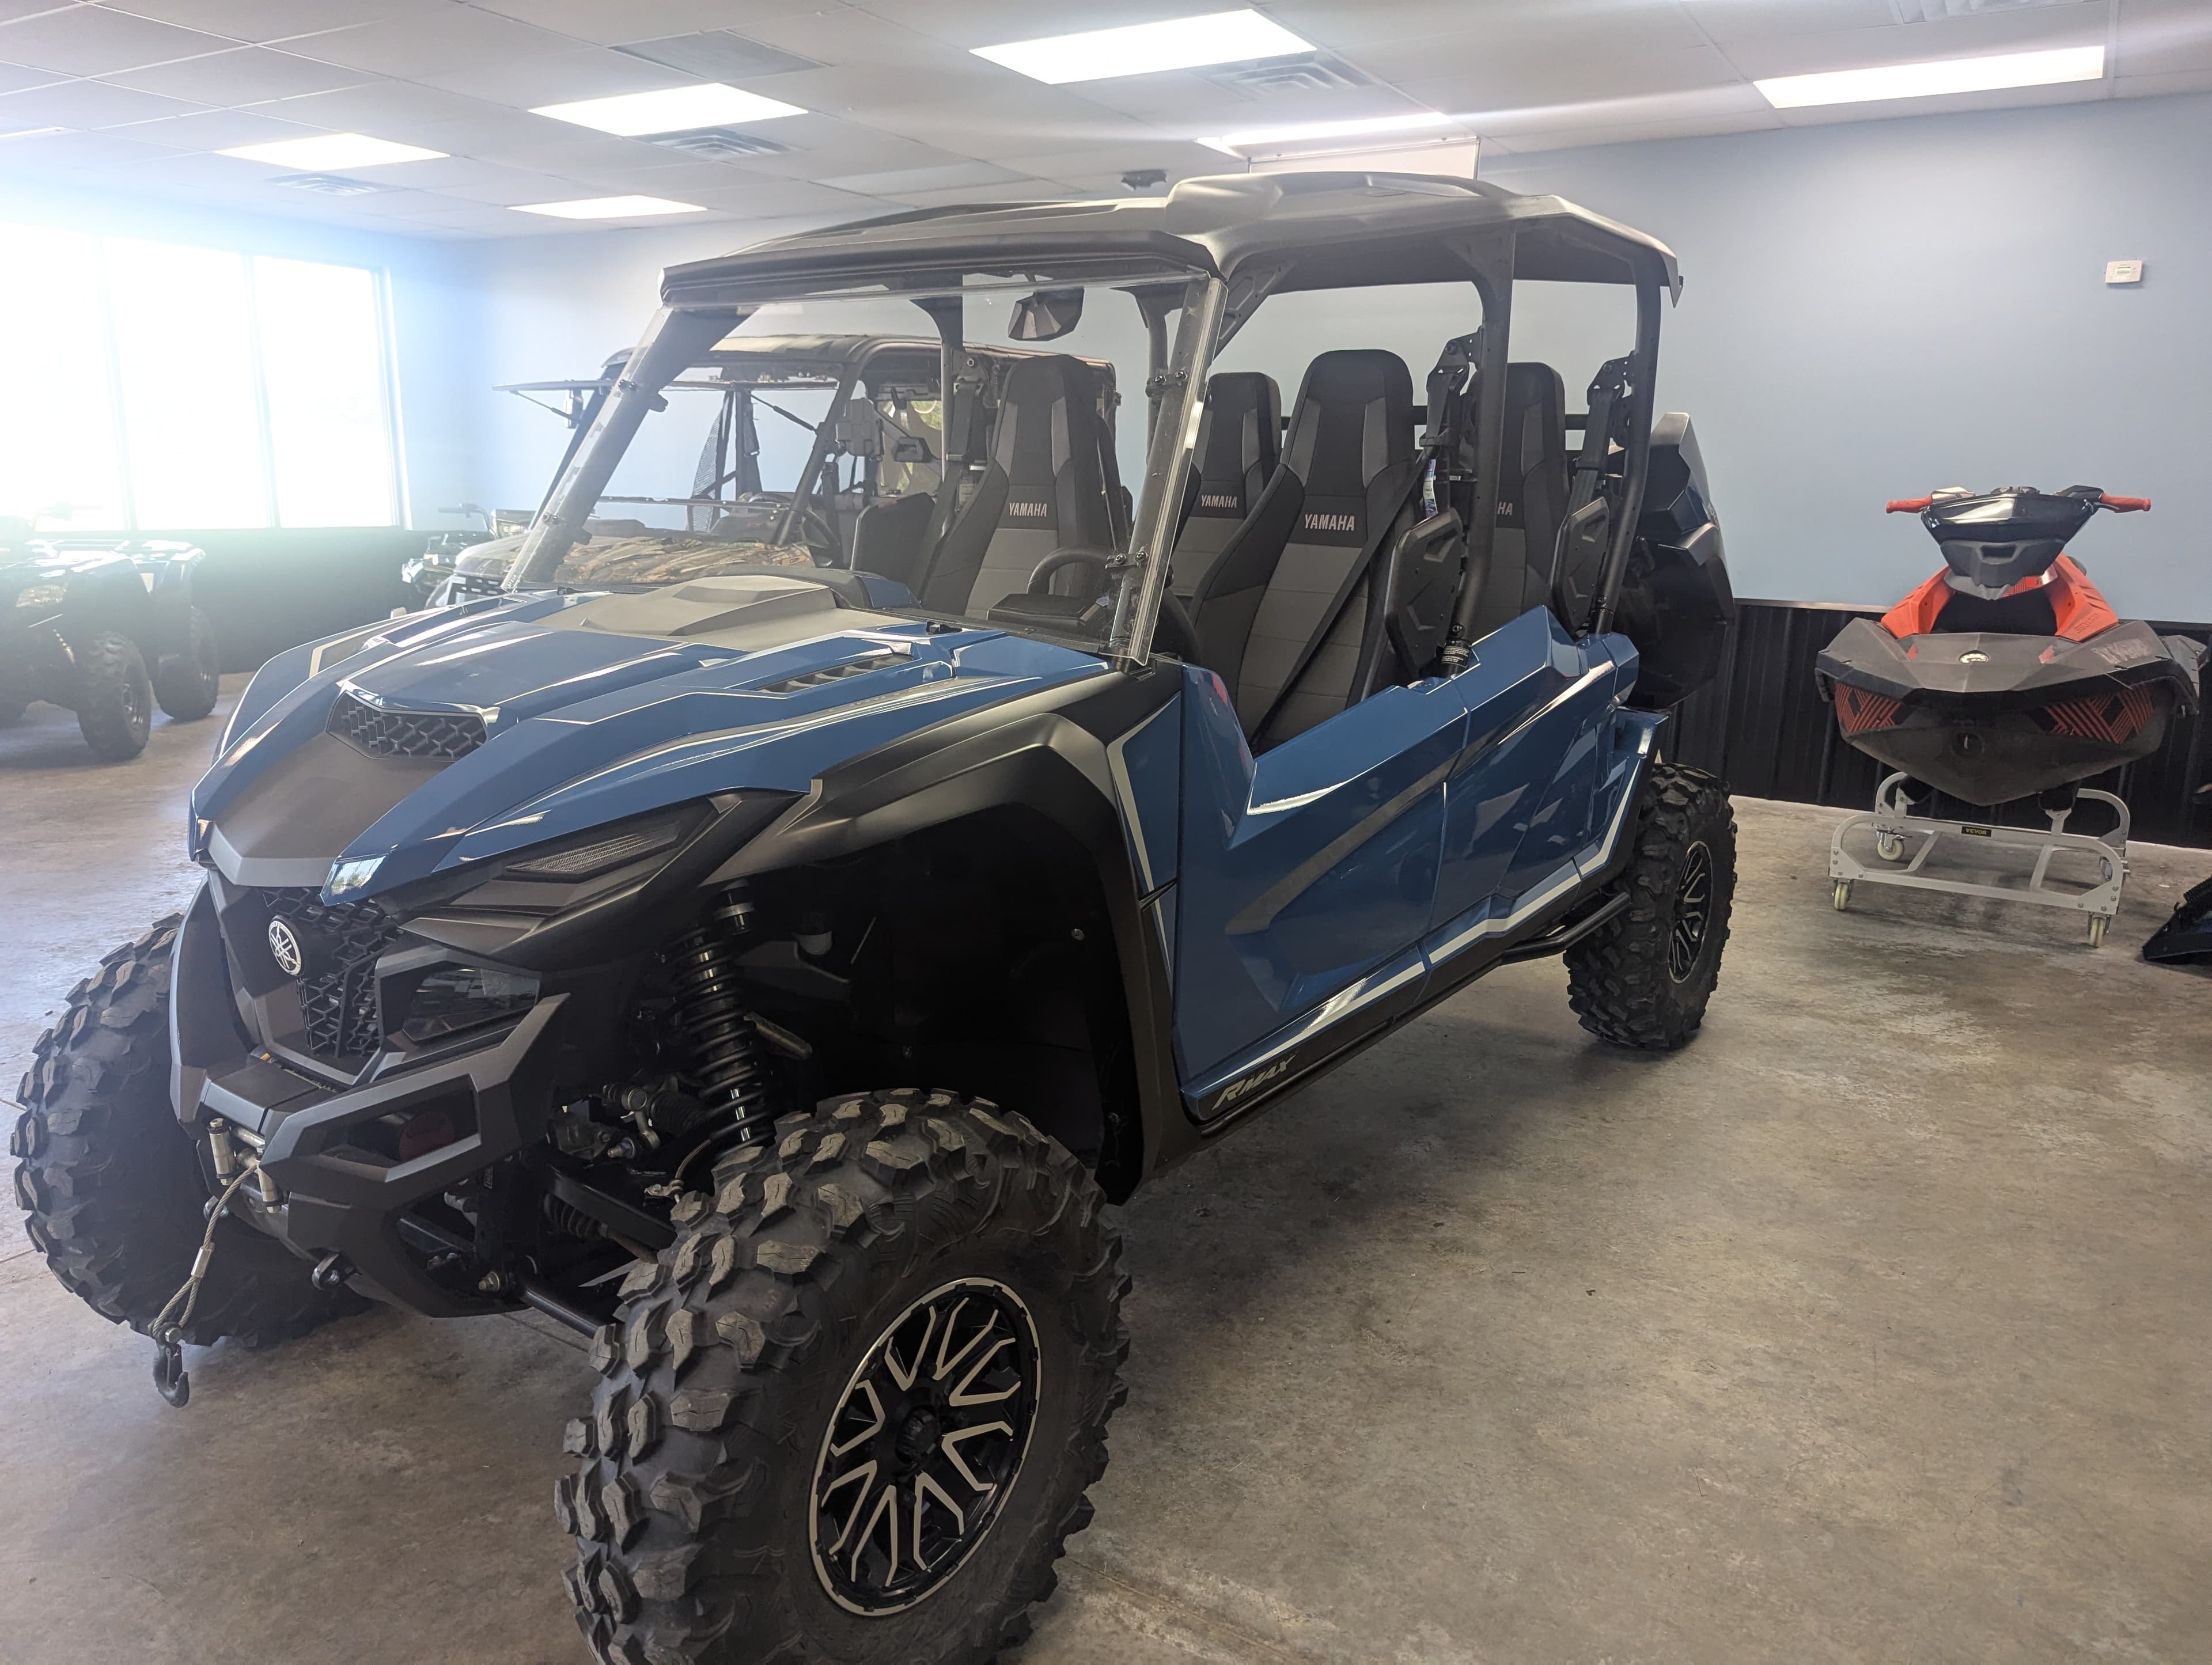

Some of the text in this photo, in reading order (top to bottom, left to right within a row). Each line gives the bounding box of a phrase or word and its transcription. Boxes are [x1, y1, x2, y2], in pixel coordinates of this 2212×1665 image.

[1009, 502, 1047, 517] YAMAHA
[1201, 495, 1237, 508] YAMAHA
[1305, 514, 1355, 531] YAMAHA
[1211, 1055, 1296, 1110] RMAX
